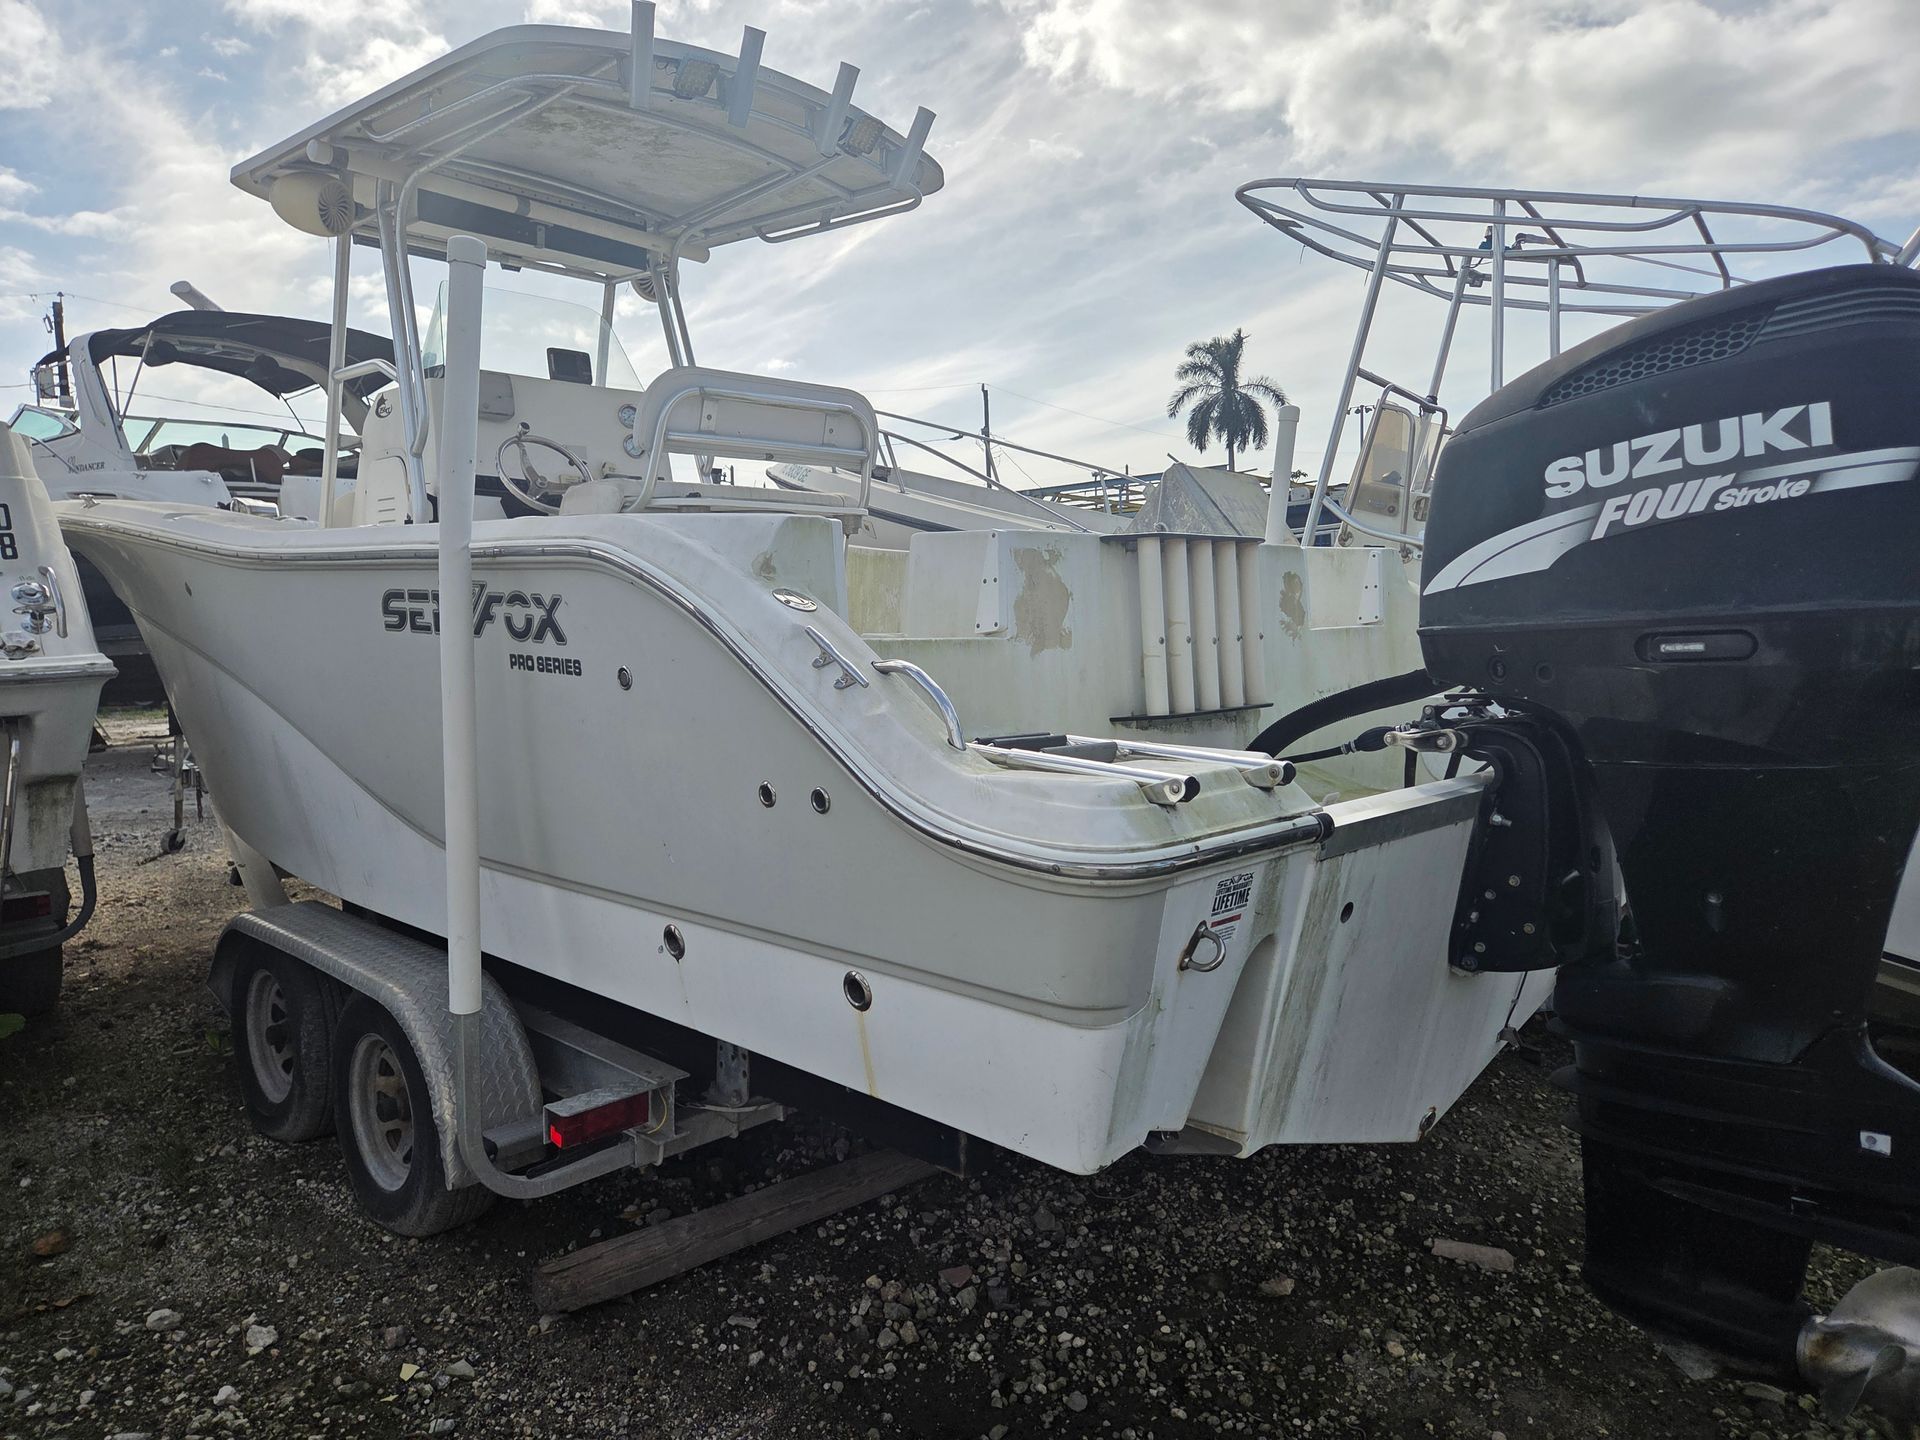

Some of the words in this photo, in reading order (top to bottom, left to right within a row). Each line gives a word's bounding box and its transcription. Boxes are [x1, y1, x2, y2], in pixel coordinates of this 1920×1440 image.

[1544, 401, 1833, 499] SUZUKI
[1713, 478, 1811, 511] Stroke
[509, 653, 535, 671] PRO
[536, 655, 582, 677] SERIES
[1212, 888, 1251, 912] LIFETIME
